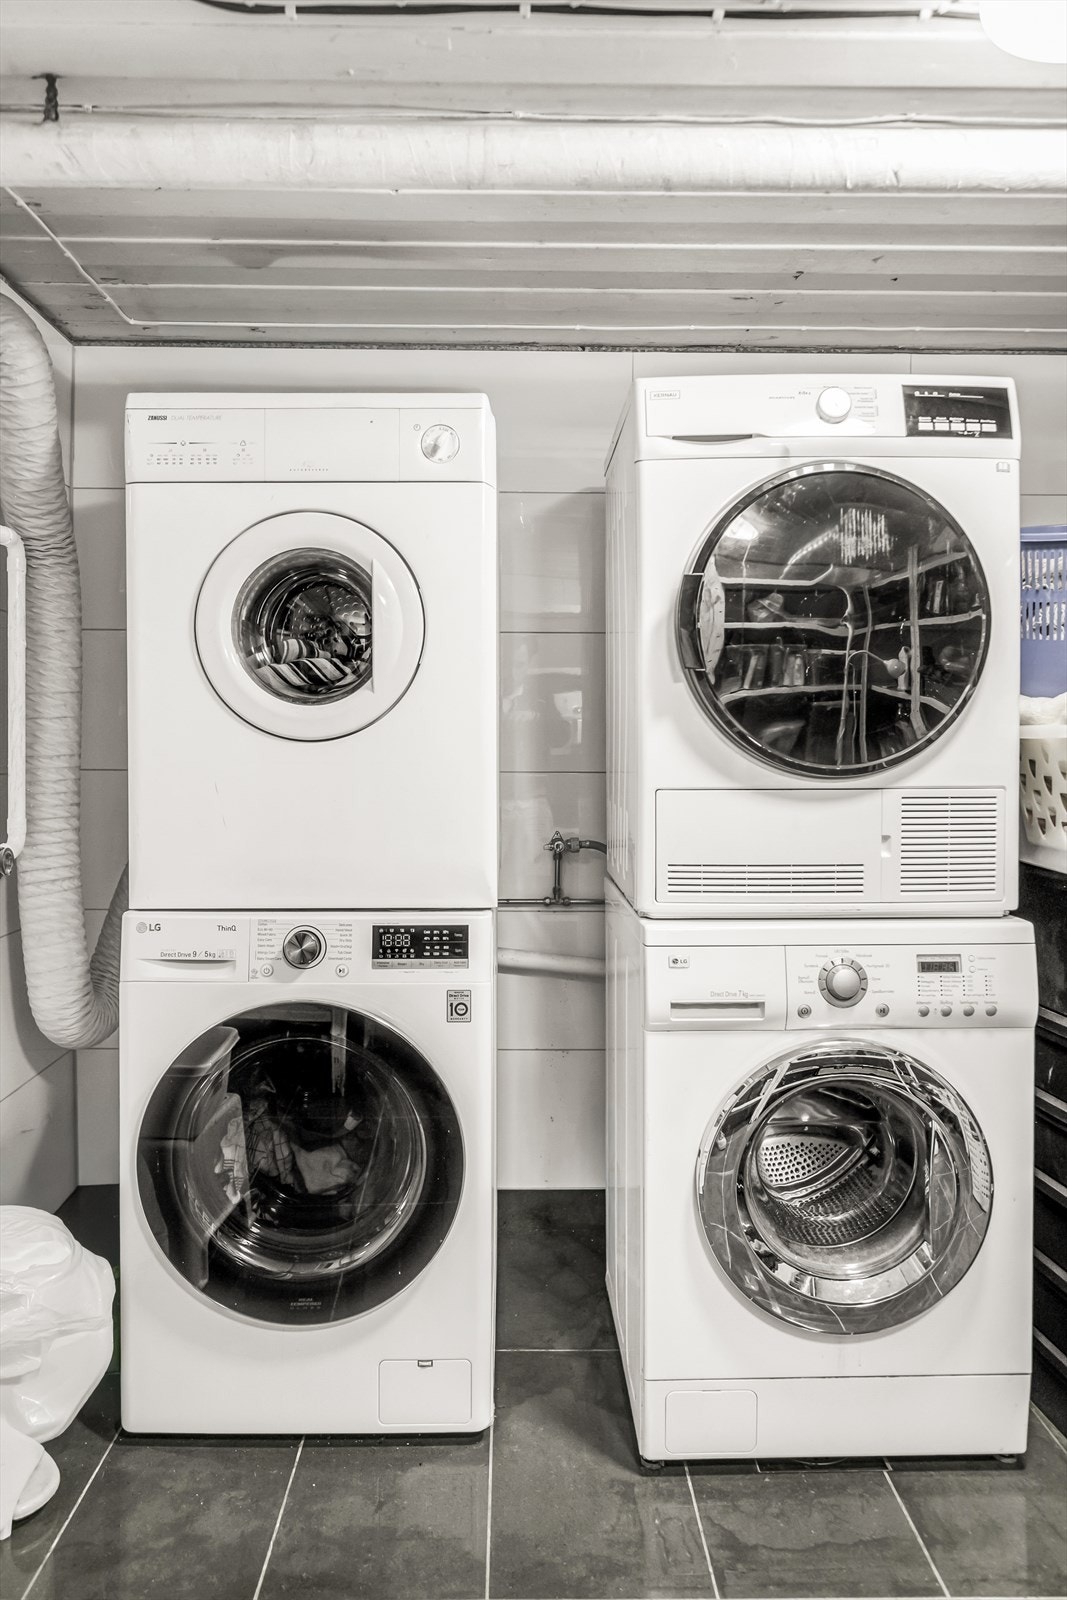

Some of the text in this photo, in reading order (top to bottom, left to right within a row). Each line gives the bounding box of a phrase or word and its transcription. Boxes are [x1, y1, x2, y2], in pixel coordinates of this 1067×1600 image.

[148, 923, 161, 932] LG
[217, 924, 237, 932] ThinQ
[160, 950, 177, 958] Direct
[177, 950, 192, 958] Drive
[192, 950, 197, 958] 9
[710, 990, 724, 998] Direct
[449, 1002, 468, 1017] 10
